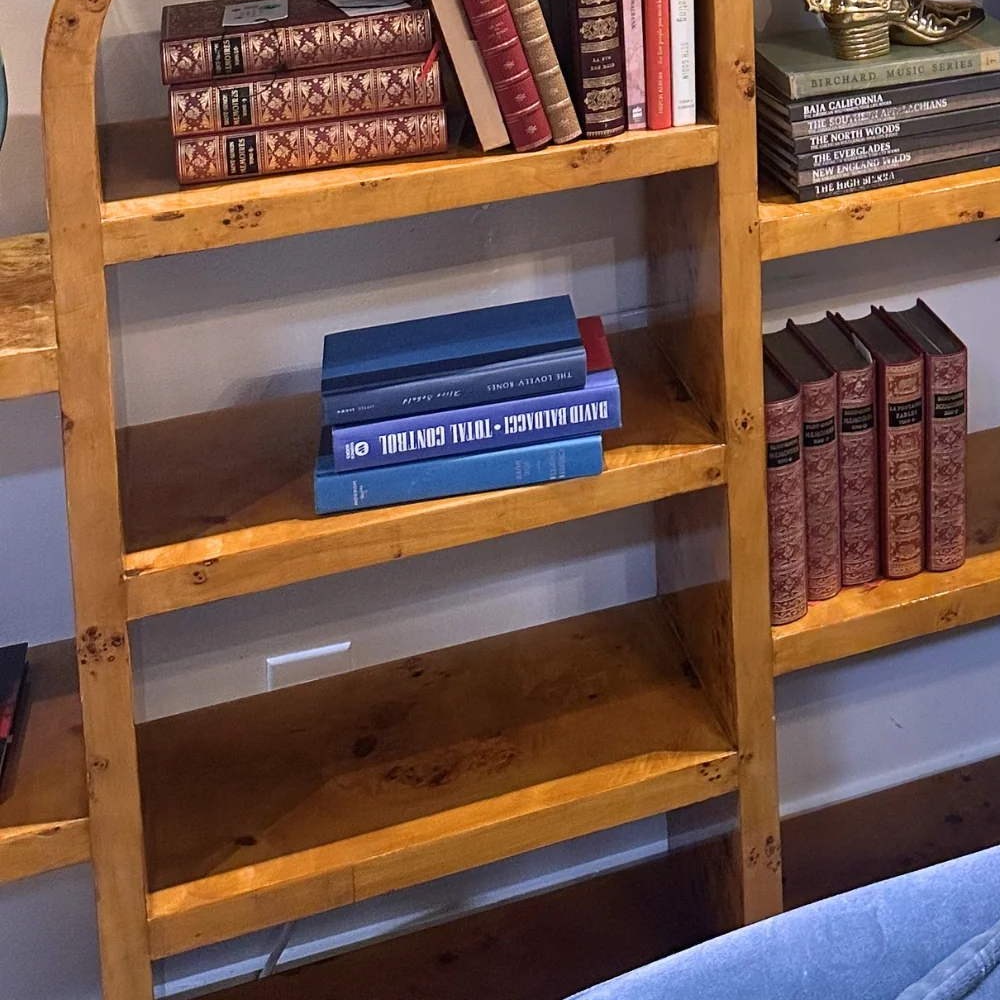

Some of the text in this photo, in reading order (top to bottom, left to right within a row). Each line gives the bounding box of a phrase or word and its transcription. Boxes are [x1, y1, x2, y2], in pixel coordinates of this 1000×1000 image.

[681, 60, 690, 81] GODIN
[811, 59, 974, 88] BIRCHARD MUSIC SERIES
[803, 105, 827, 115] BAJA
[828, 93, 883, 110] CALIFORNIA
[807, 120, 827, 131] THE
[810, 136, 830, 147] THE
[831, 128, 864, 143] NORTH
[865, 123, 901, 137] WOODS
[813, 153, 832, 164] THE
[834, 141, 891, 160] EVERGLADES
[812, 167, 834, 180] NEW
[837, 158, 880, 174] ENGLAND
[815, 183, 834, 195] THE
[836, 178, 860, 191] HIGH
[486, 380, 515, 392] BONES
[555, 371, 572, 381] THE
[379, 401, 609, 455] DAVID BALDACCI TOTAL CONTROL
